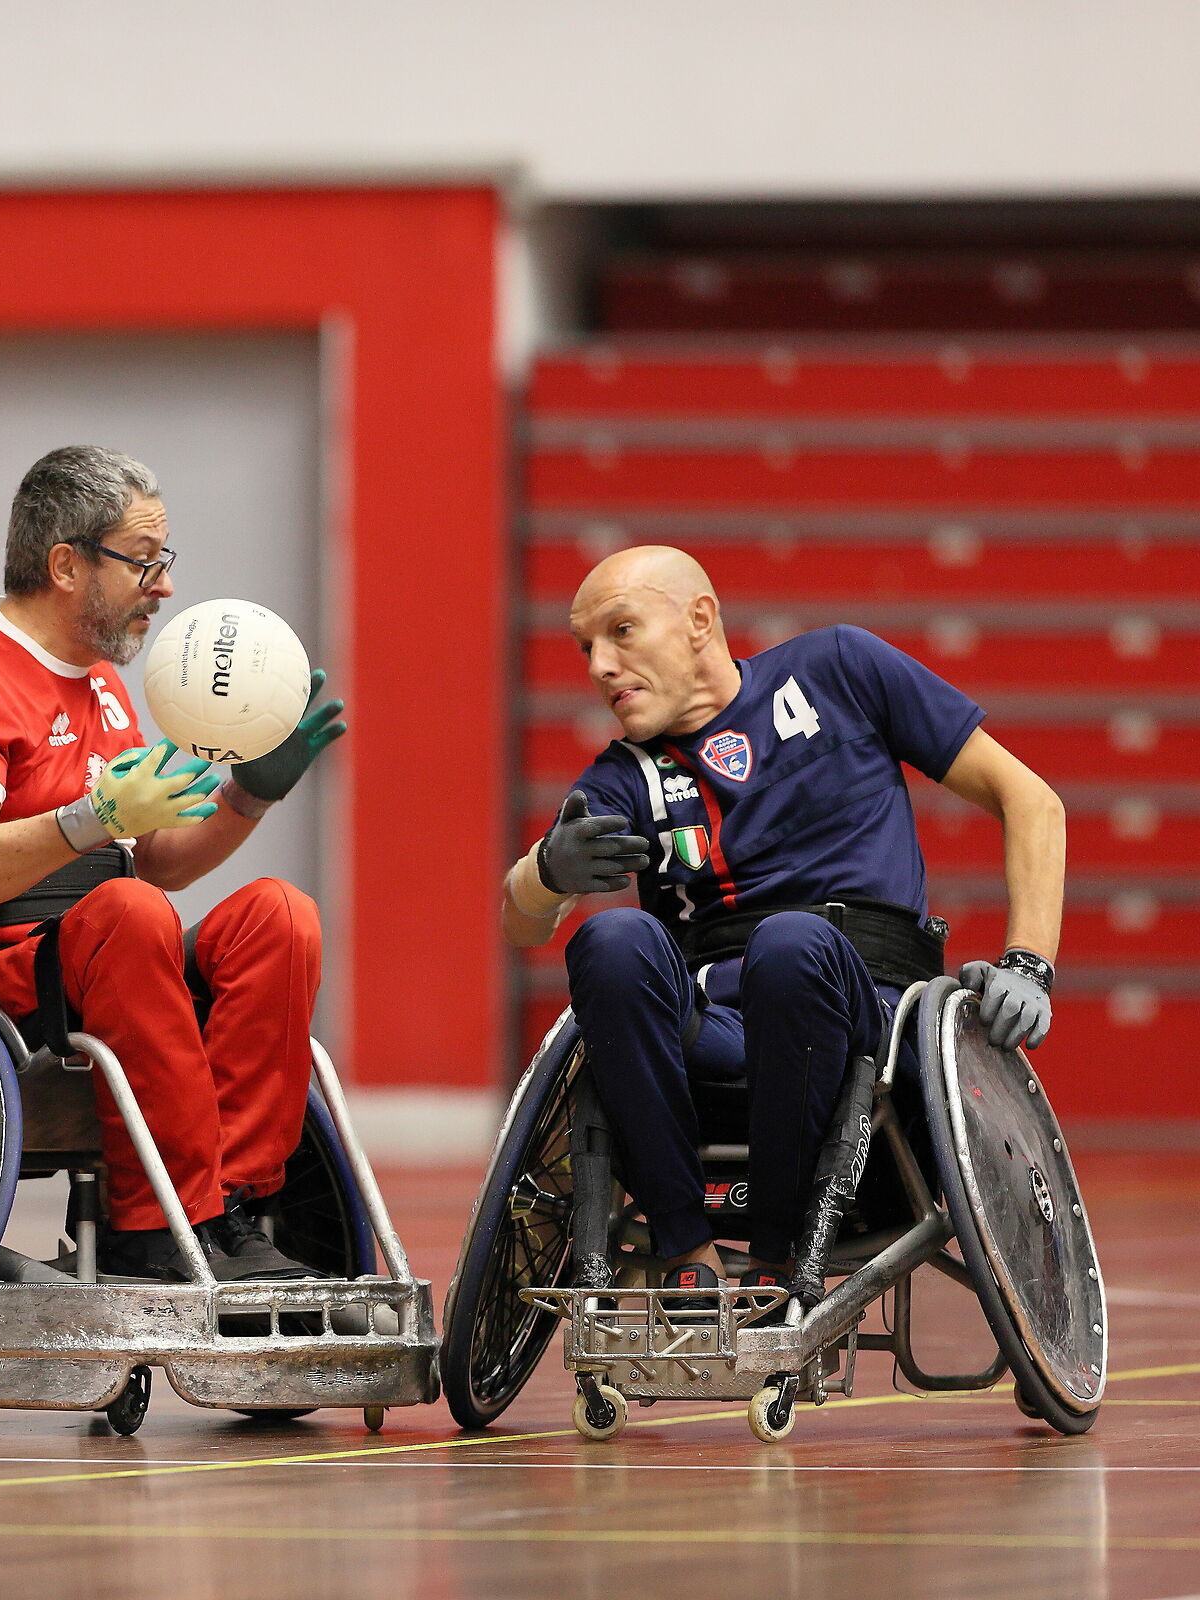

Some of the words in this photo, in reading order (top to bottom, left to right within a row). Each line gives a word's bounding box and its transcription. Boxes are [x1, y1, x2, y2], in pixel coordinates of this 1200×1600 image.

[180, 640, 190, 688] Wheelchair
[185, 618, 199, 640] Rugby
[211, 613, 240, 697] molten
[90, 677, 130, 732] 15
[773, 675, 821, 741] 4
[192, 743, 244, 764] ITA
[665, 787, 699, 803] errea
